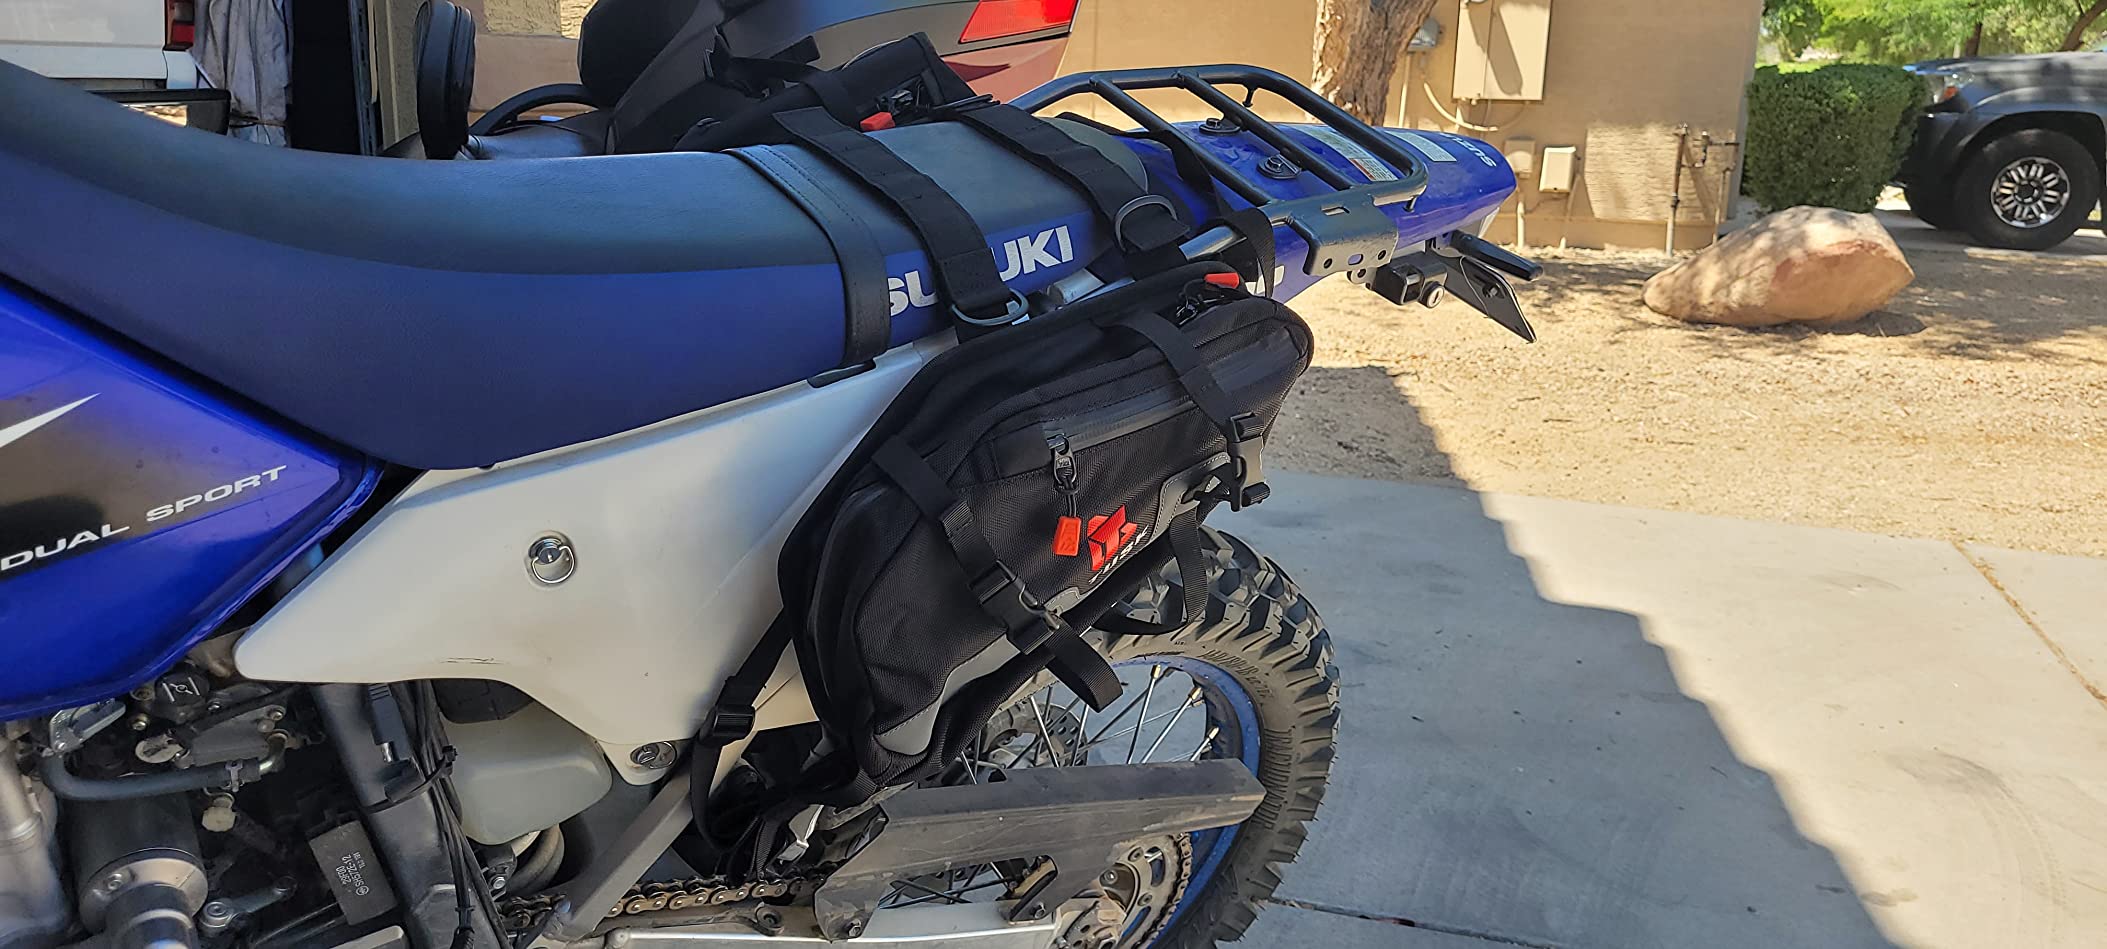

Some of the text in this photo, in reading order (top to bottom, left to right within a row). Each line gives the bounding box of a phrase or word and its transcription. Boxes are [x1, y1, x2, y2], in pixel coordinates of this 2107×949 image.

[887, 225, 1074, 317] SUUKI
[0, 465, 287, 571] DUAL SPORT
[1088, 524, 1150, 585] TUSK
